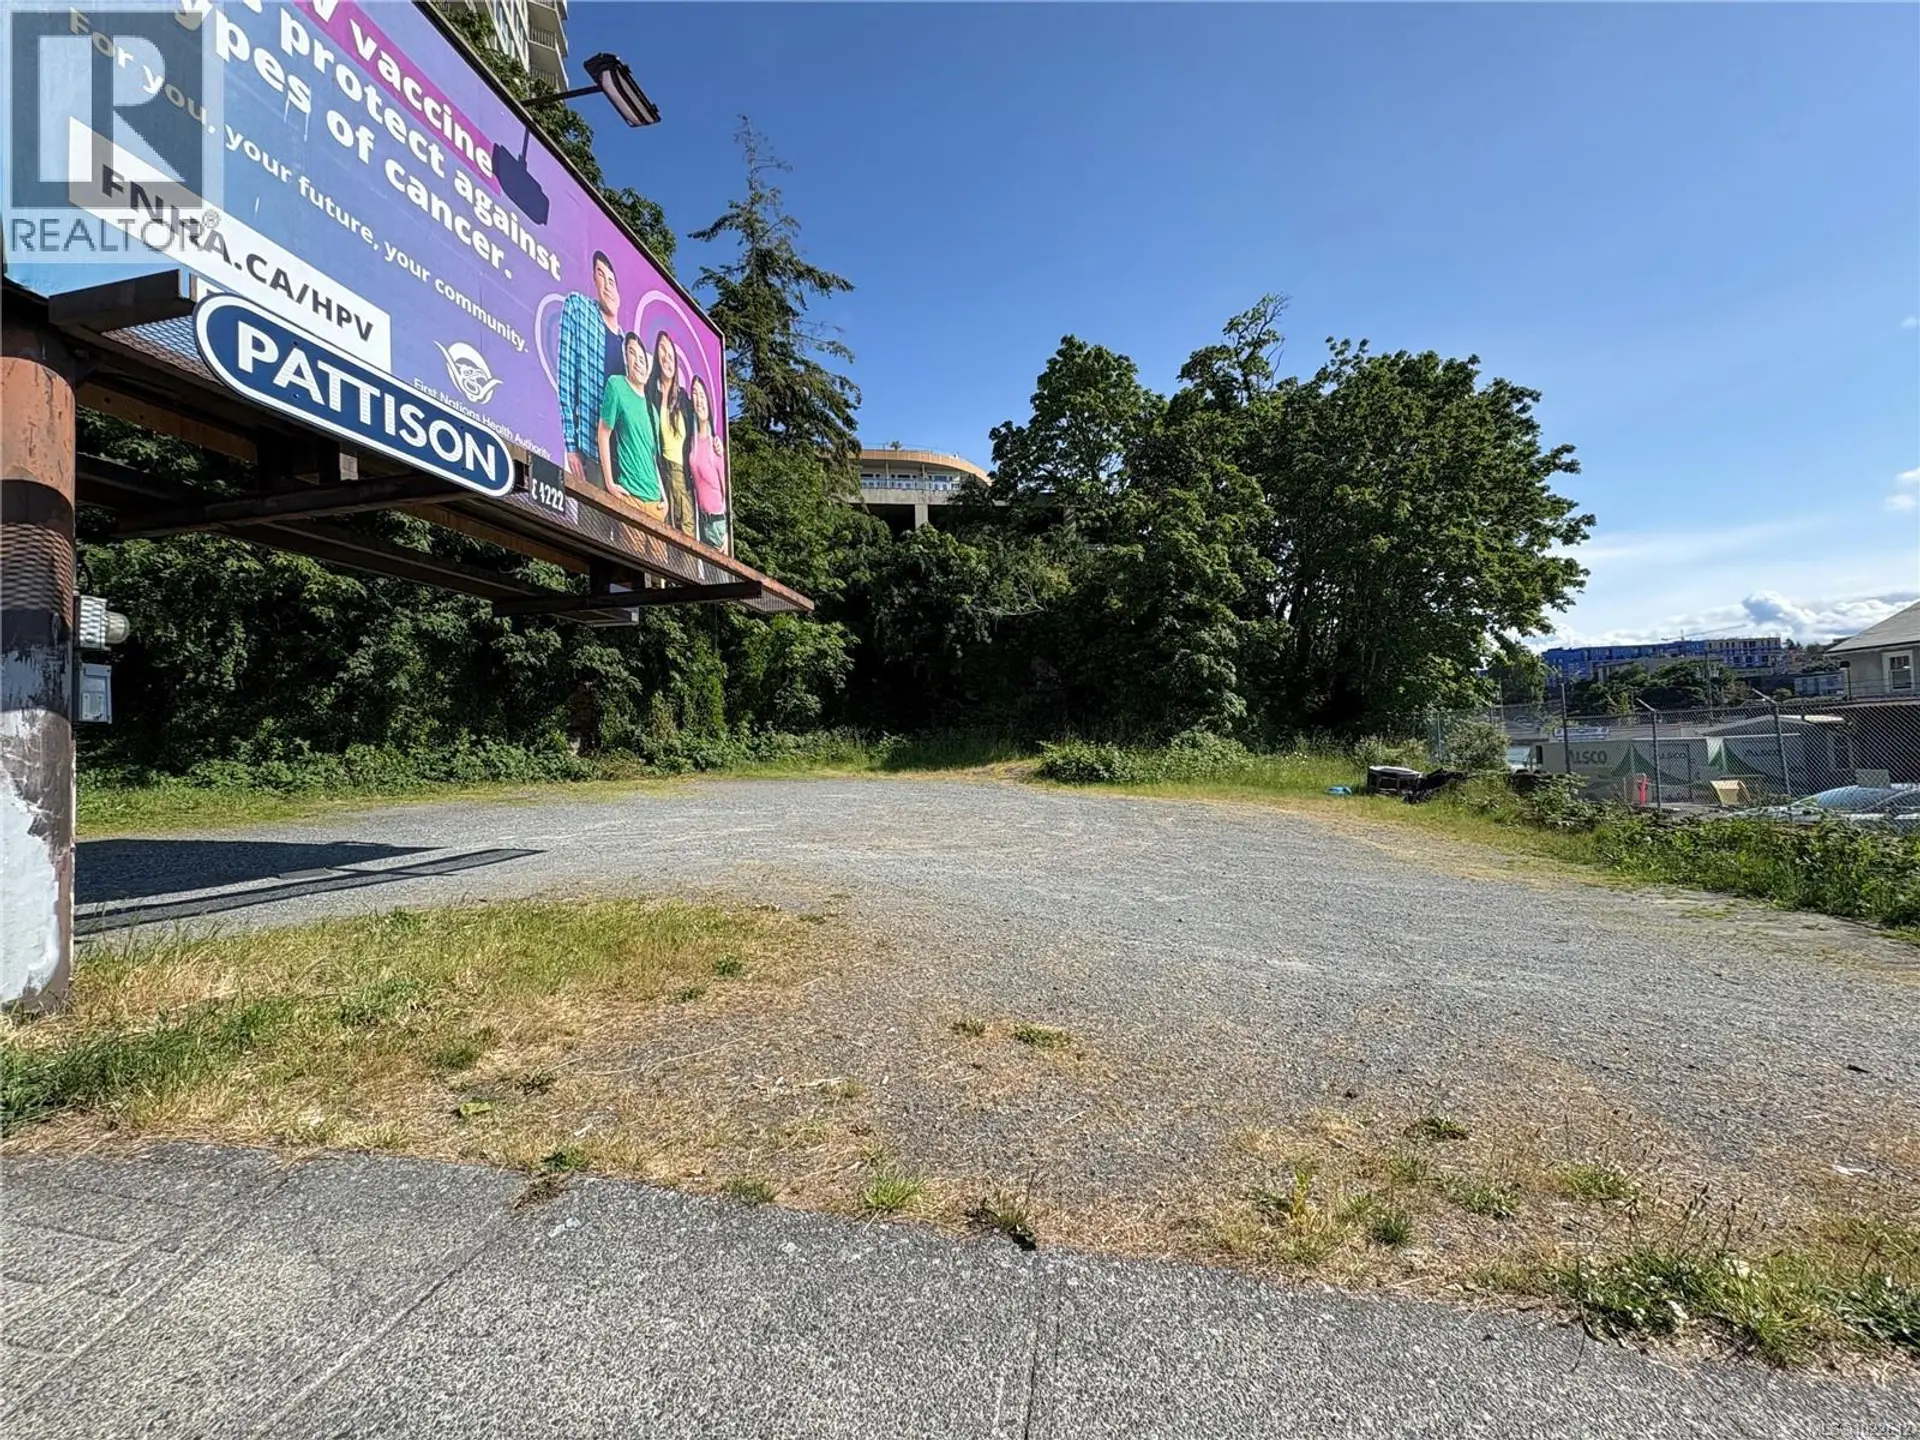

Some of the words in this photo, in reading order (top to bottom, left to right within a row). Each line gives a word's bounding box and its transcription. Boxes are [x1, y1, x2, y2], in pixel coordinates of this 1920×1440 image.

[69, 7, 134, 68] For
[224, 123, 293, 184] your
[298, 175, 380, 251] future,
[384, 241, 431, 283] your
[435, 279, 530, 354] community.
[281, 8, 446, 179] protect
[455, 169, 562, 282] against
[350, 18, 494, 178] vaccine
[326, 110, 375, 165] of
[385, 158, 513, 280] cancer.
[237, 320, 496, 482] PATTISON
[413, 378, 438, 398] First
[440, 392, 481, 421] Nations
[482, 413, 513, 441] Health
[514, 433, 553, 460] Authority
